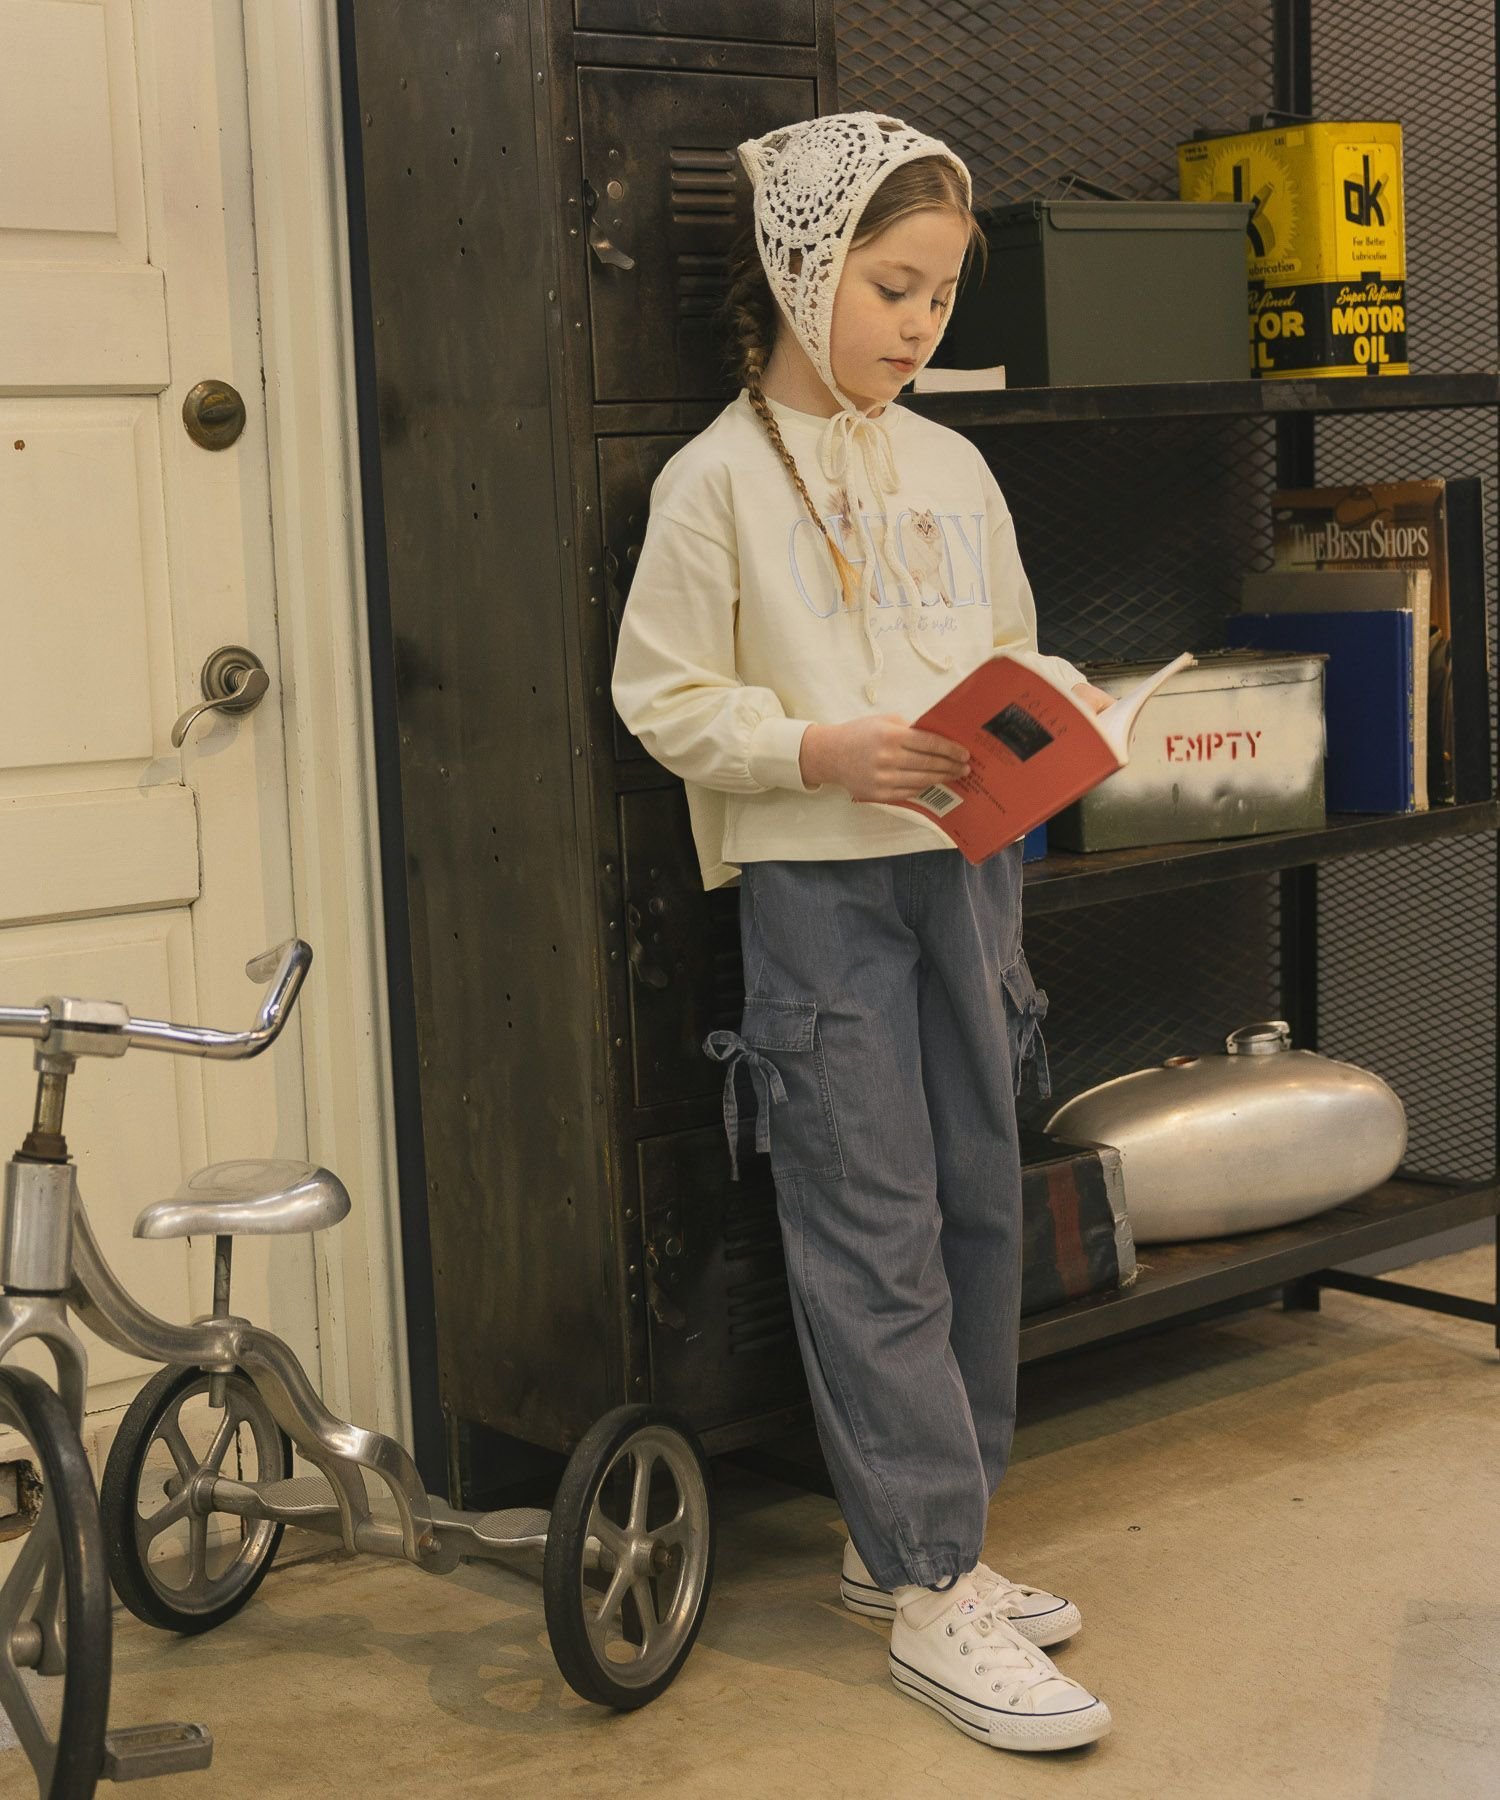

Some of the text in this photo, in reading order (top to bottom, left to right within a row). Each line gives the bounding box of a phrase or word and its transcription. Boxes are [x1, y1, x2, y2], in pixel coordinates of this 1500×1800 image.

[1248, 259, 1296, 276] ubrication
[1336, 283, 1402, 306] Super Refined
[1248, 310, 1305, 340] TOR
[1331, 305, 1405, 336] MOTOR
[1249, 341, 1275, 369] IL
[1353, 335, 1390, 364] OIL
[1370, 519, 1430, 559] SHOPS
[1166, 730, 1263, 763] EMPTY
